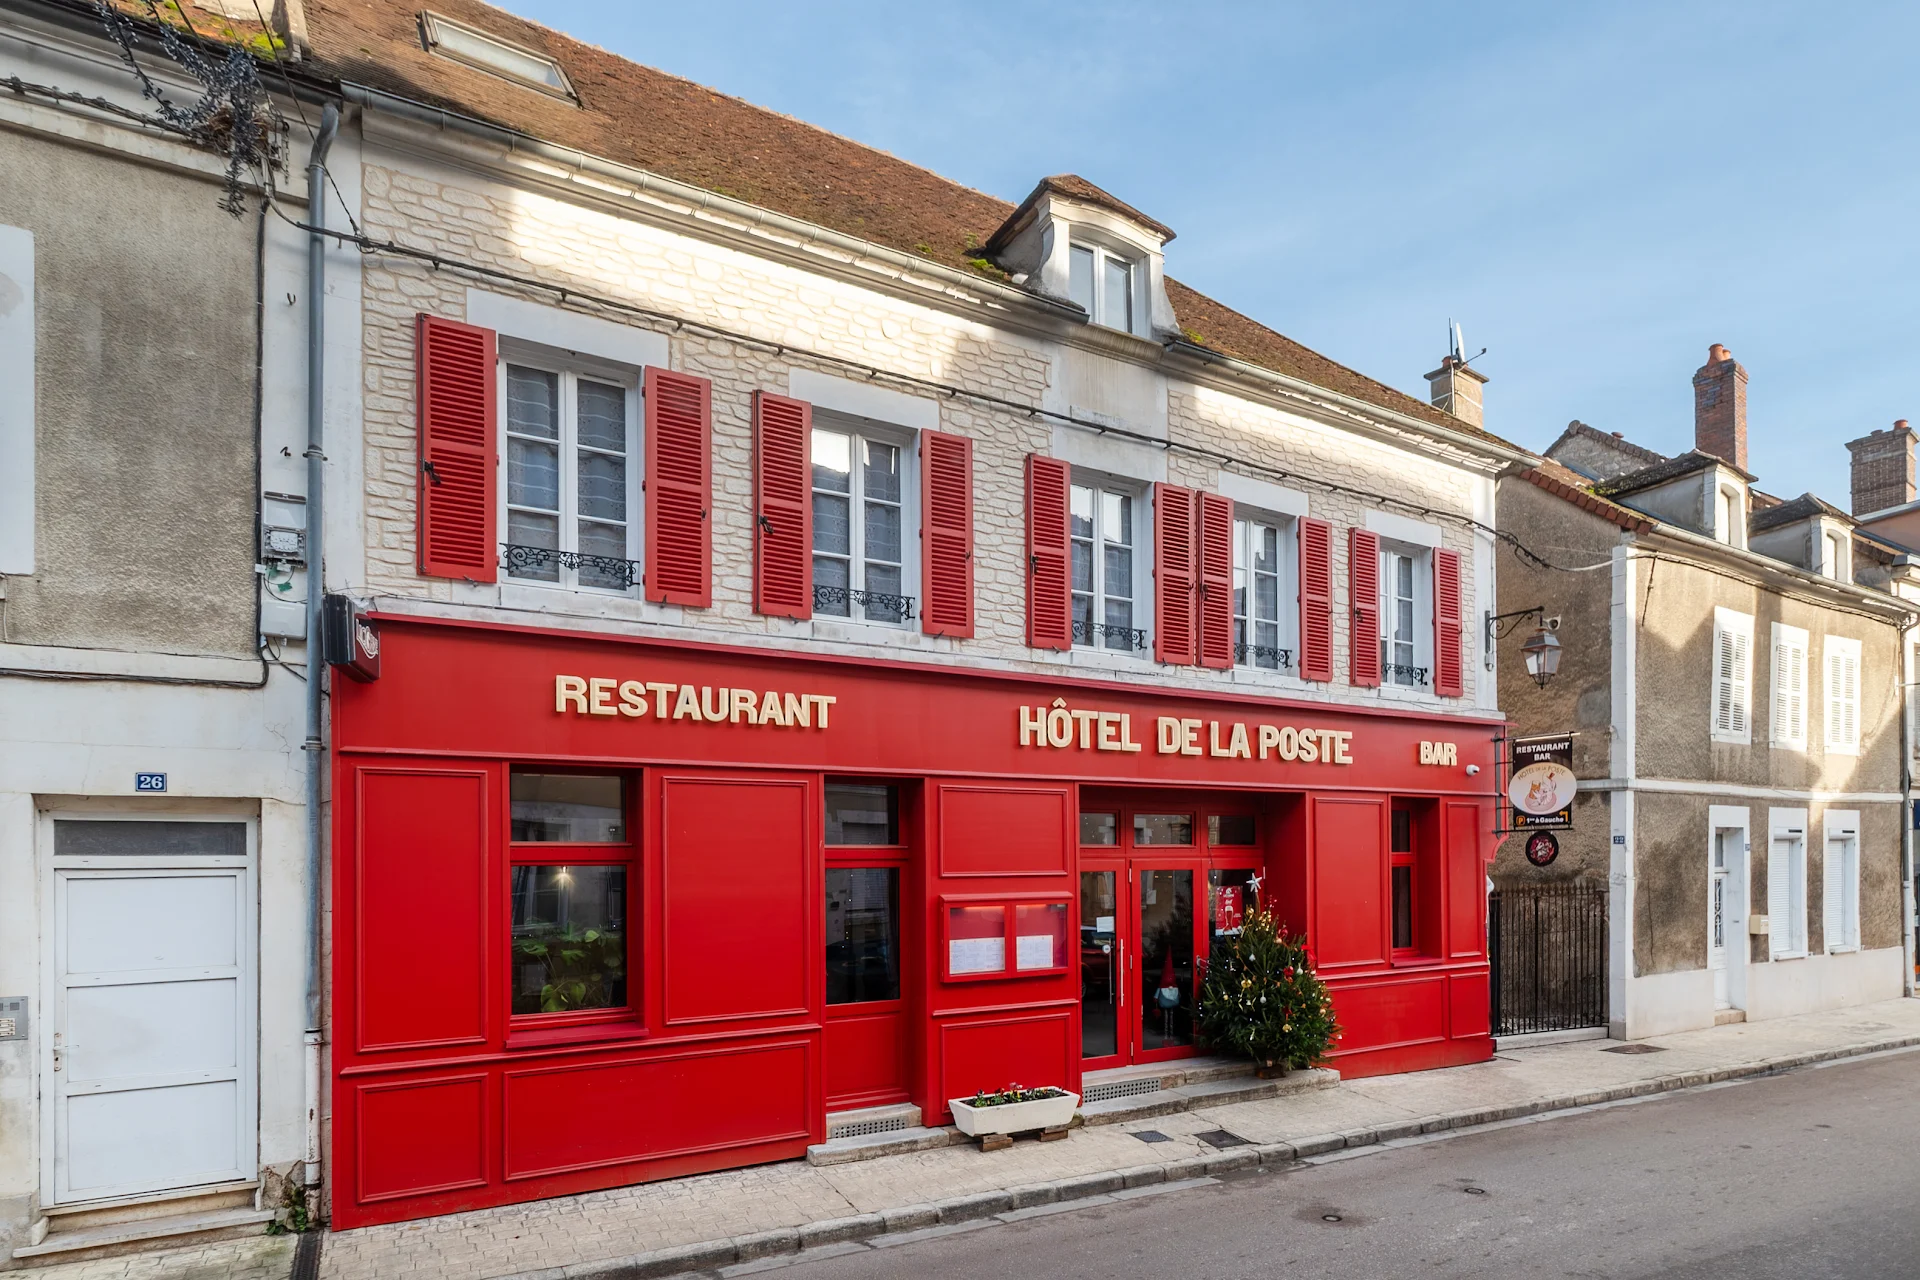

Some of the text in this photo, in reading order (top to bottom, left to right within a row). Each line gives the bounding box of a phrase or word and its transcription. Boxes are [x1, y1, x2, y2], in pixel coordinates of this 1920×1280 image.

[555, 674, 837, 729] RESTAURANT
[1019, 697, 1354, 765] HÔTEL DE LA POSTE
[1419, 741, 1458, 767] BAR
[1516, 741, 1570, 754] RESTAURANT
[1533, 752, 1551, 761] BAR
[1547, 765, 1566, 777] POSTE
[140, 775, 163, 789] 26
[1540, 816, 1564, 824] Gauche
